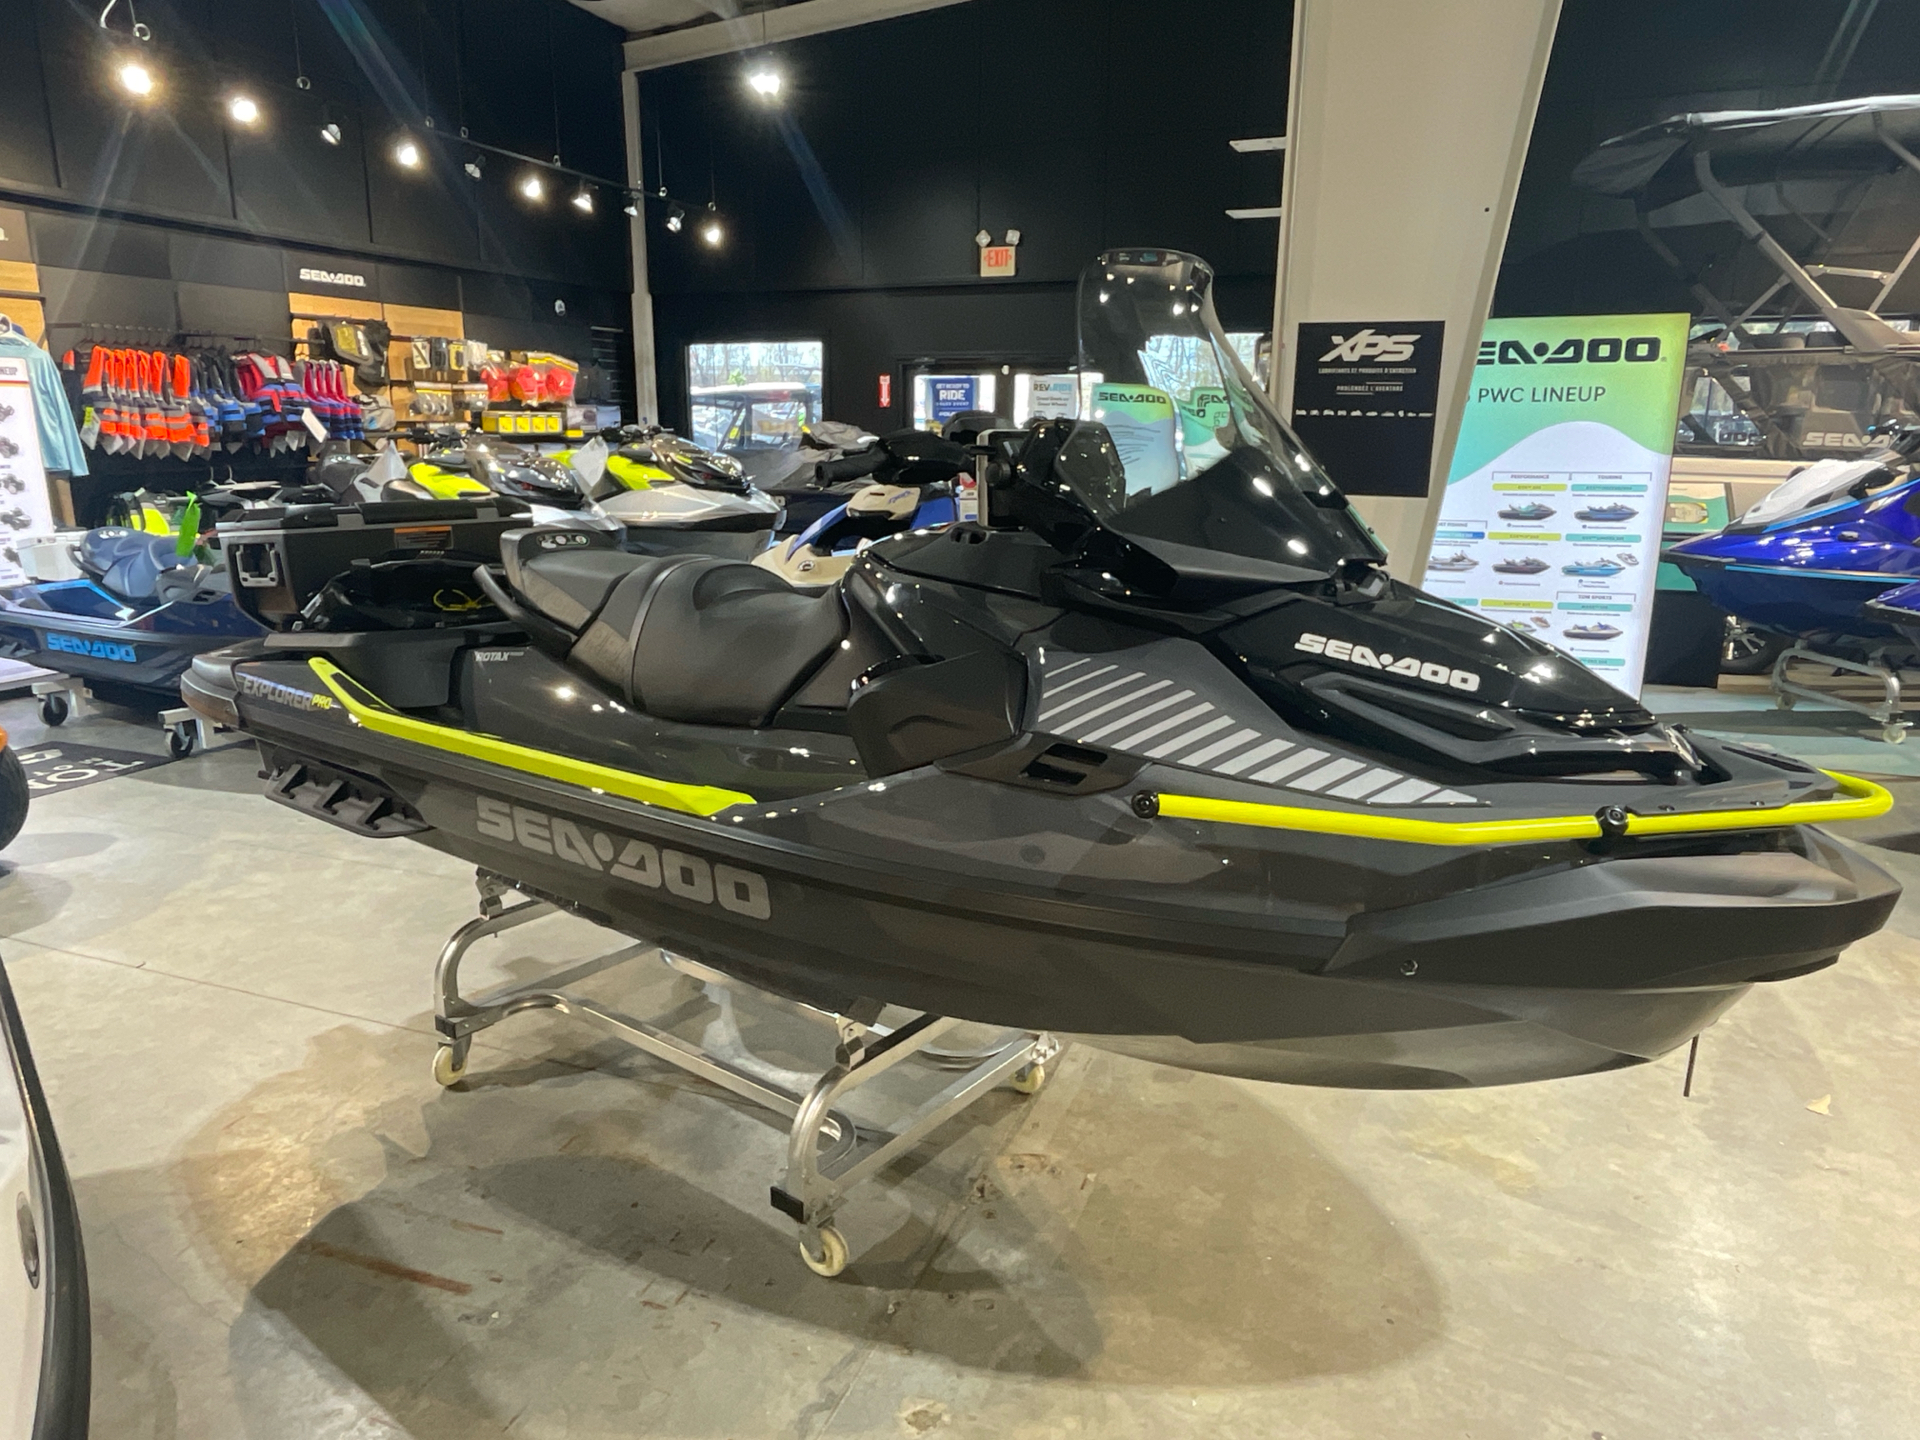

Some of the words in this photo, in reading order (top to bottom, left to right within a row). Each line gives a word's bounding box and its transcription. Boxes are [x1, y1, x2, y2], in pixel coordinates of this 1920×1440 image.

[987, 248, 1009, 267] EXIT
[1318, 329, 1421, 362] XPS
[939, 389, 966, 401] RIDE
[1478, 387, 1525, 403] PWC
[1530, 386, 1606, 403] LINEUP
[243, 676, 314, 711] EXPLORER
[311, 693, 333, 710] PRO
